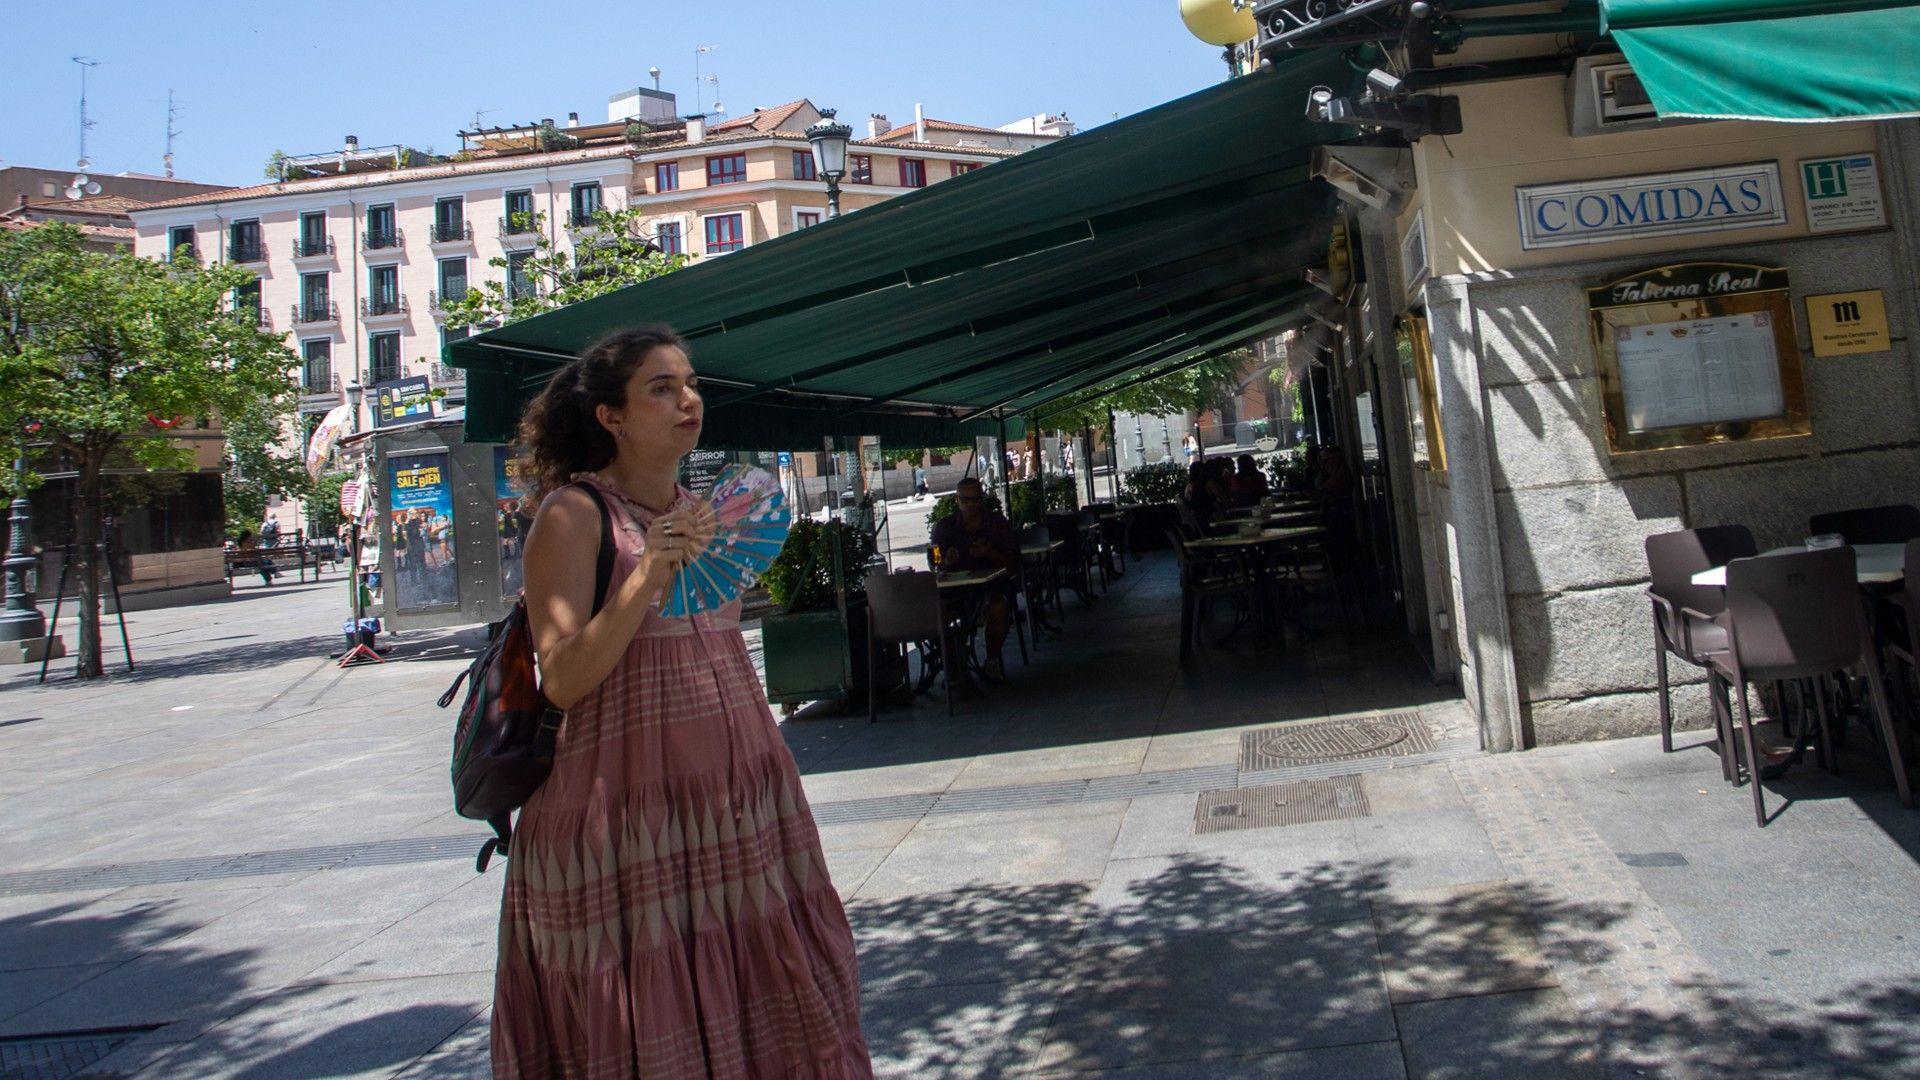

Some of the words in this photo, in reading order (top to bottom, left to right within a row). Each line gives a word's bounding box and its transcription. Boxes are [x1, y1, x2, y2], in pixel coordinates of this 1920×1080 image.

[1807, 163, 1846, 196] H
[1537, 179, 1762, 232] COMIDAS
[1612, 281, 1700, 303] Taberna
[1707, 269, 1762, 293] Real
[397, 475, 418, 488] SALE
[418, 473, 441, 488] BIEN
